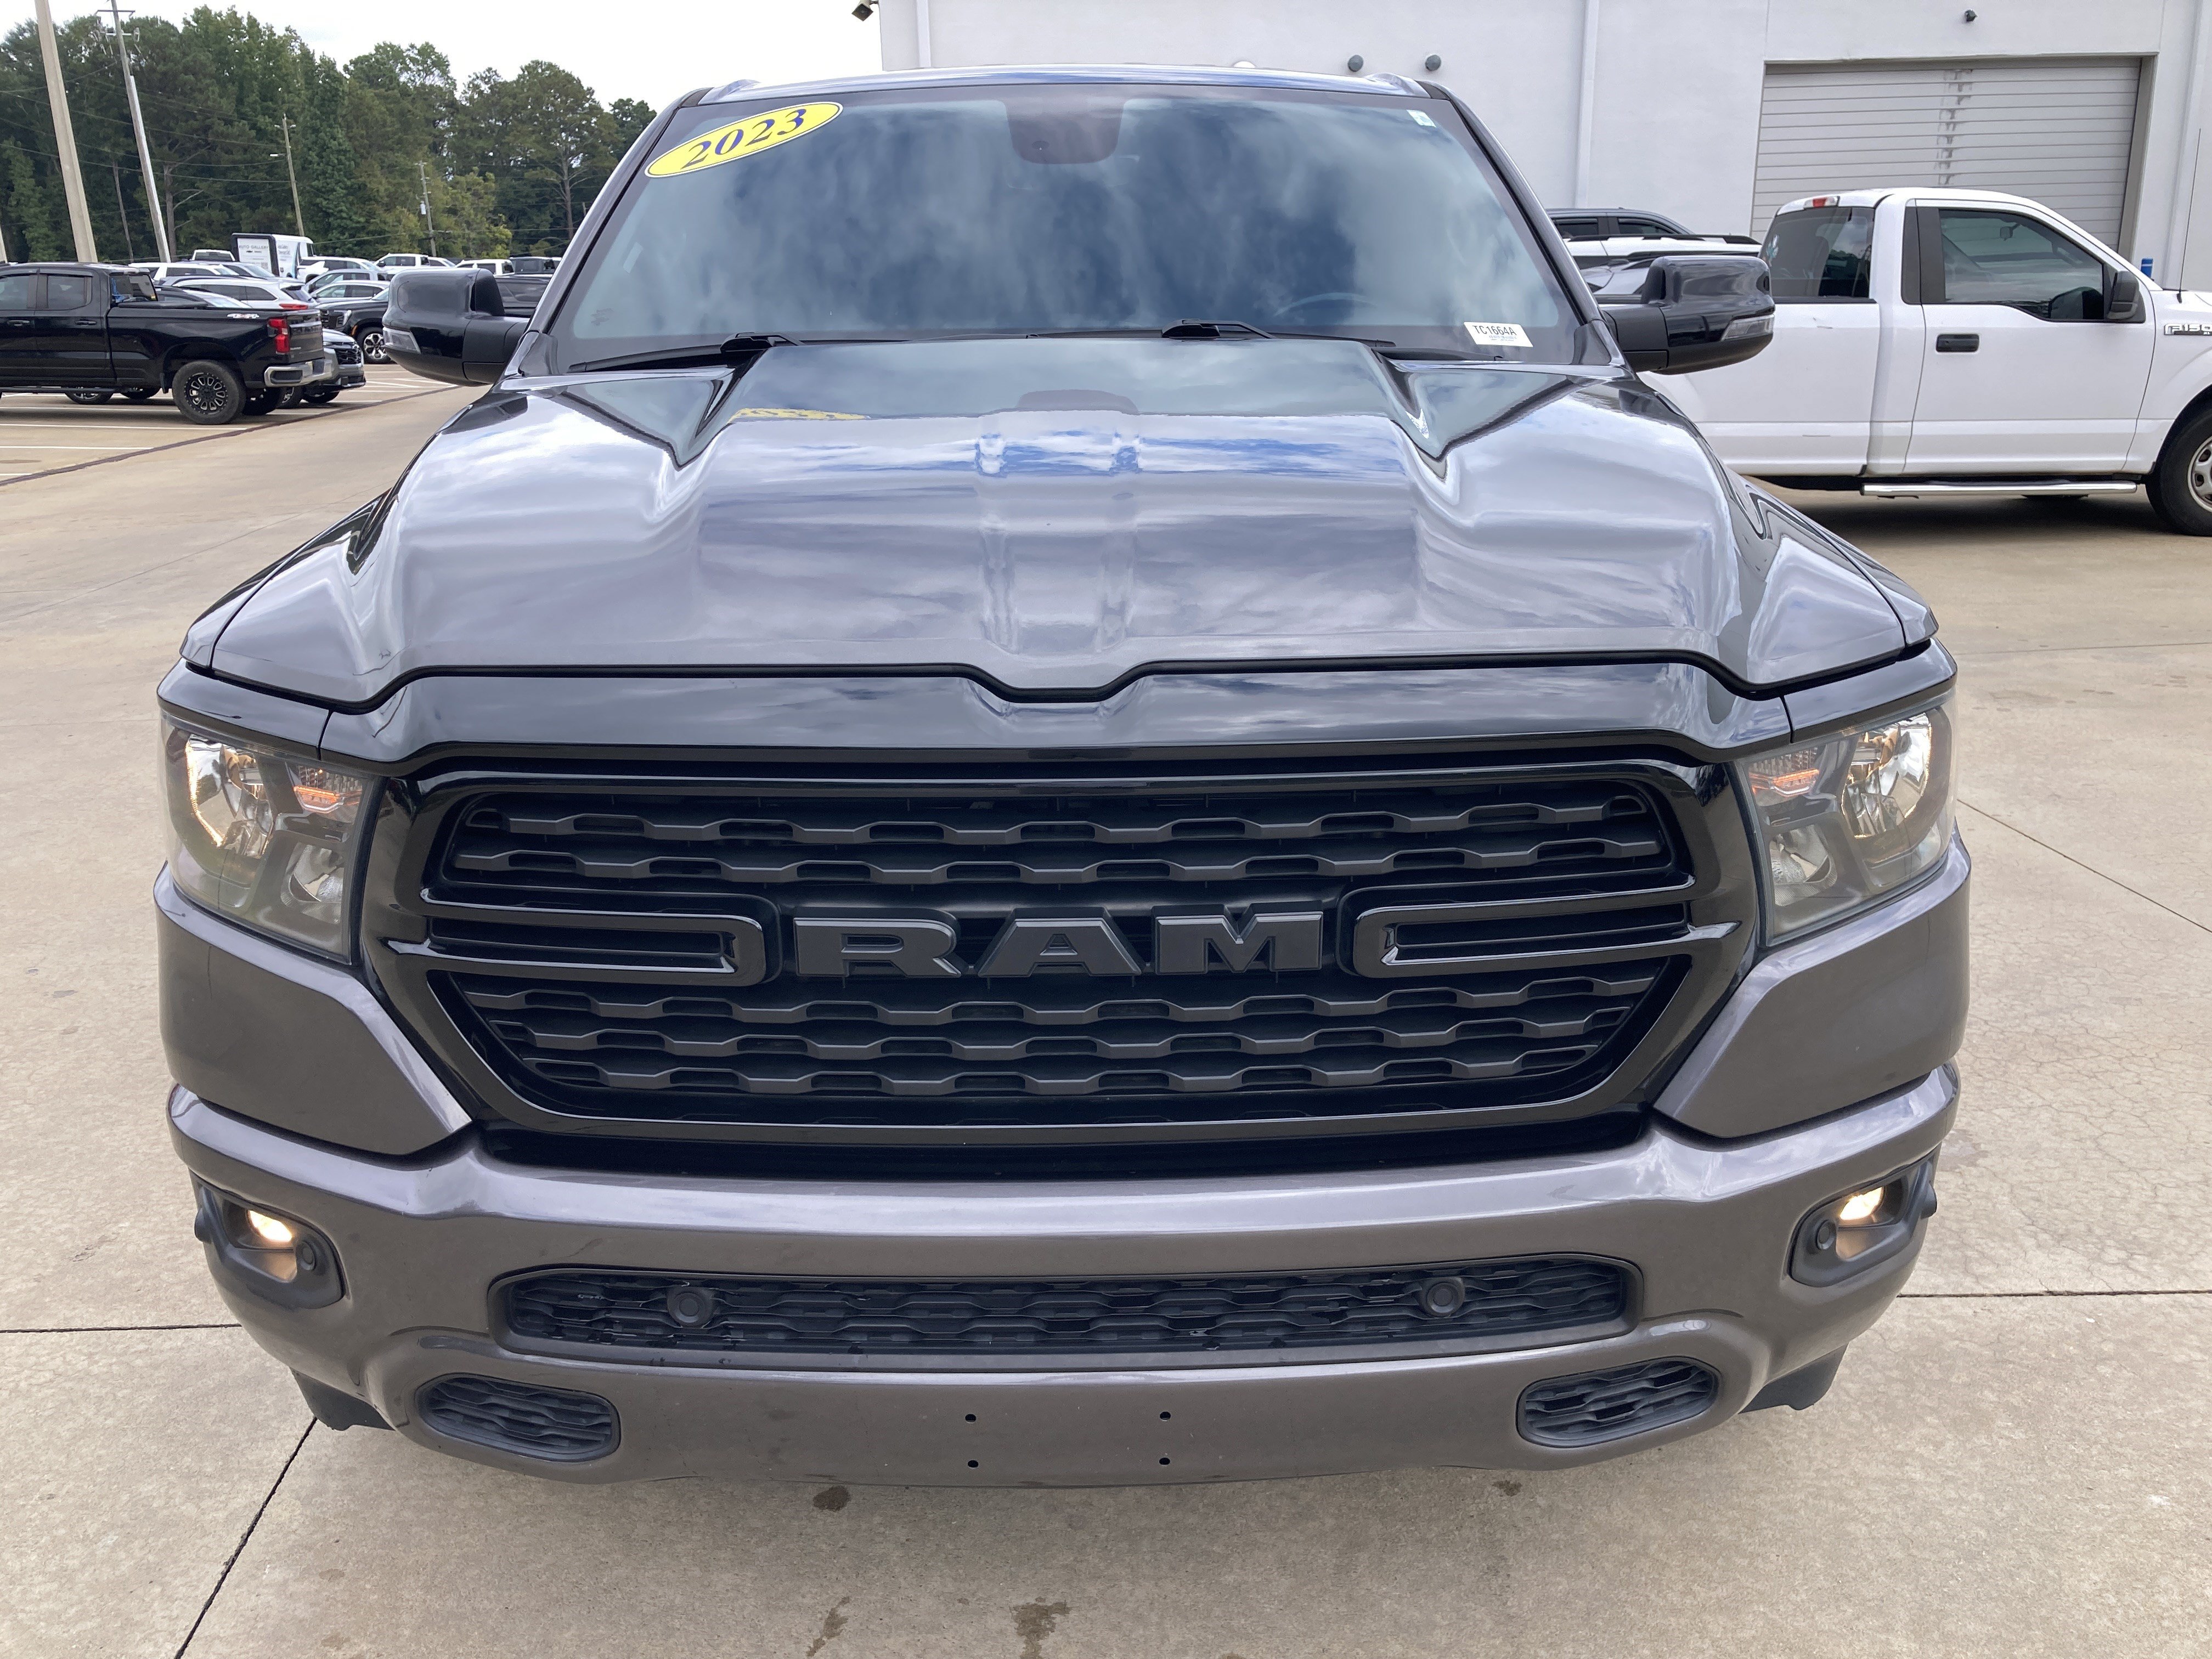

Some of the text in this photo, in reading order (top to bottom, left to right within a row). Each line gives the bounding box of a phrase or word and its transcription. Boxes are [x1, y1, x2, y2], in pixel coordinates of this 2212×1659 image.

[680, 109, 806, 170] 2023
[1472, 325, 1517, 335] TC1664A
[793, 909, 1323, 978] RAM
